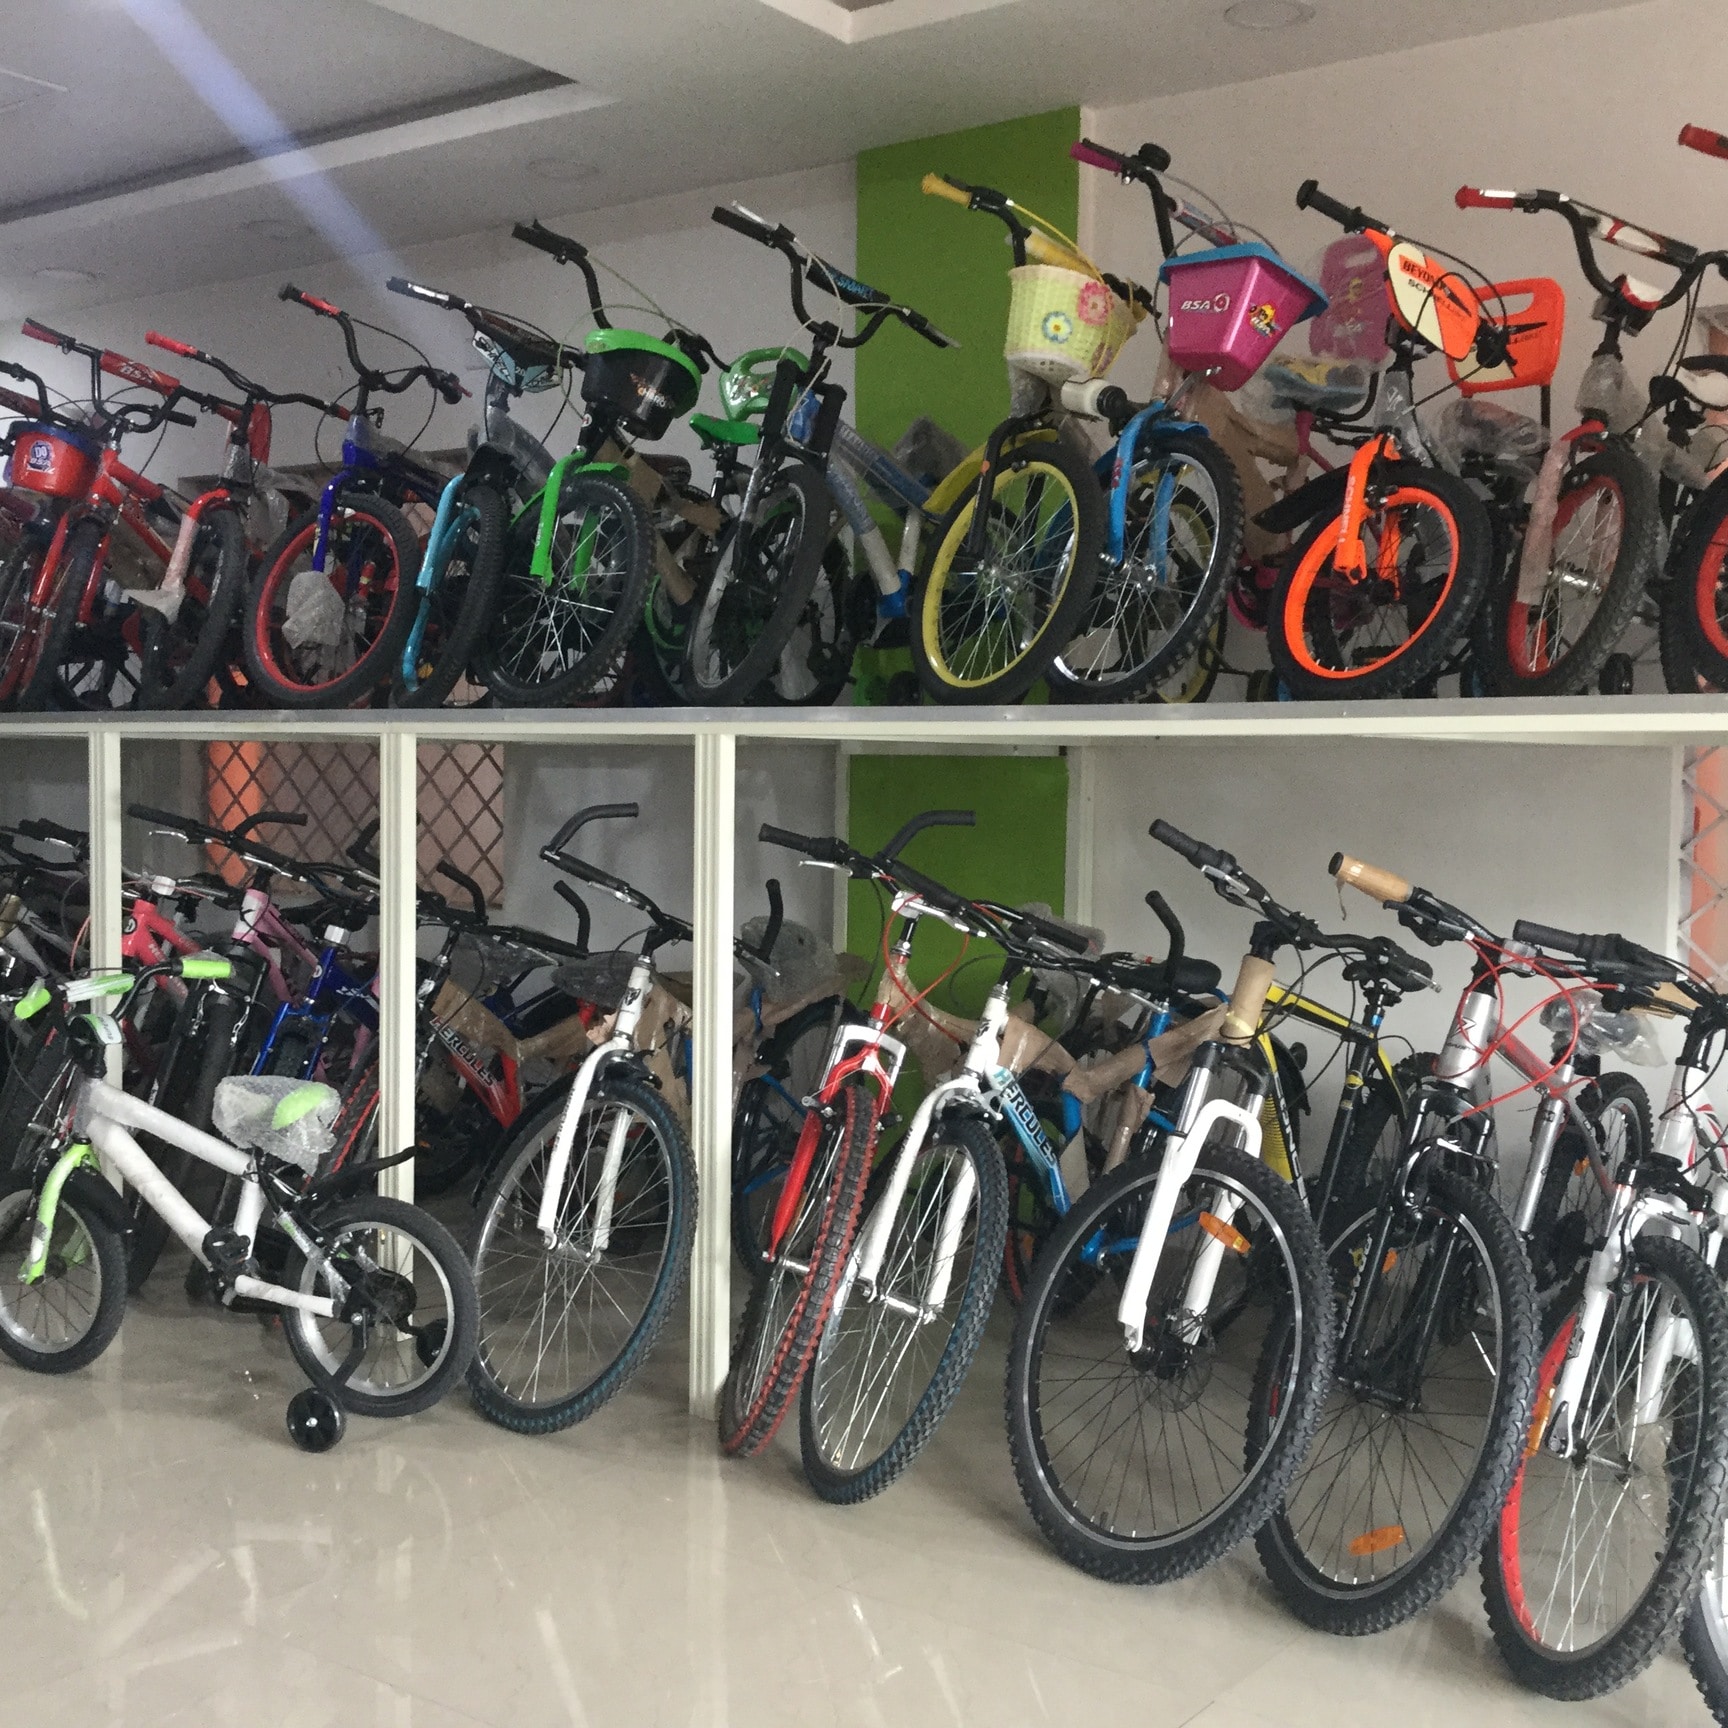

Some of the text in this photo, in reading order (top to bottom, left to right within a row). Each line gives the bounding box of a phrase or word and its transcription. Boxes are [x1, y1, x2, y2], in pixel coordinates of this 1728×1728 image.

[1180, 299, 1211, 311] BSA
[429, 1015, 498, 1087] HERCULES
[993, 1067, 1057, 1167] HERCULES
